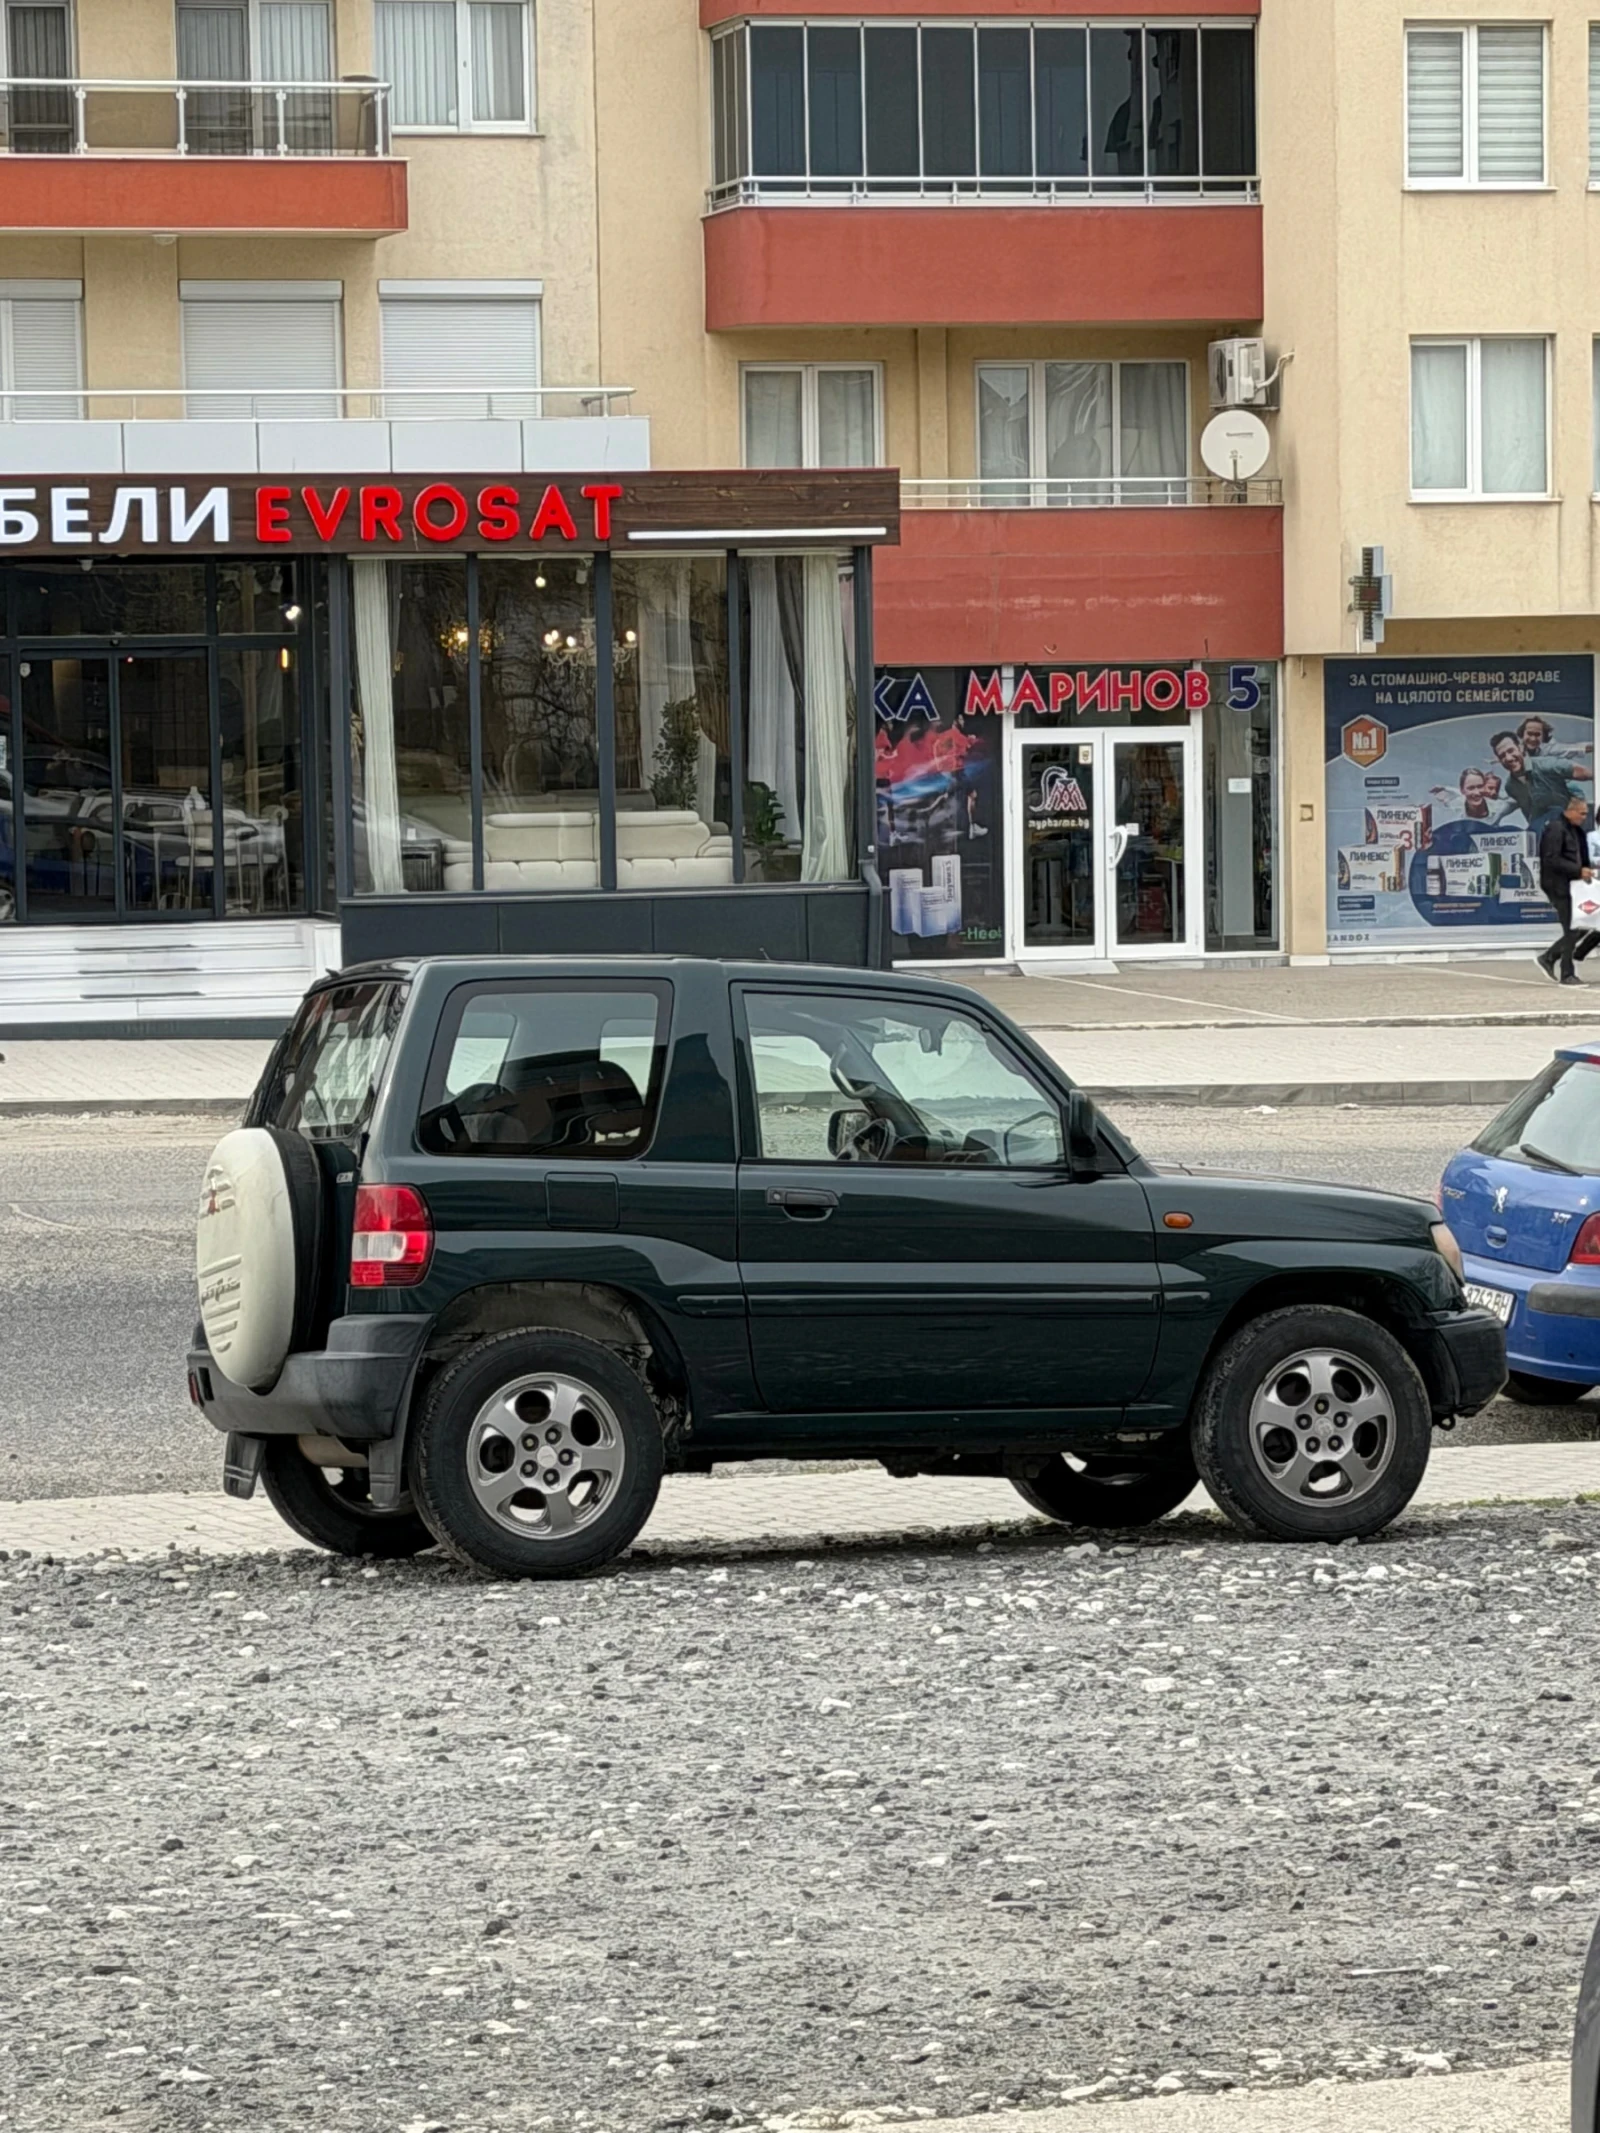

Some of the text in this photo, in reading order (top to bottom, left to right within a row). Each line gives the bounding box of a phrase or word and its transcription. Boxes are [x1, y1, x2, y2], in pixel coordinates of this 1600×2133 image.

[255, 484, 623, 541] EVROSAT
[1349, 670, 1561, 686] ЗА СТОМАШНО-ЧРЕВНО ЗДРАВЕ
[964, 668, 1211, 715] МАРИНОВ
[1225, 665, 1260, 712] 5
[1375, 688, 1535, 706] НА ЦЯЛОТО СЕМЕЙСТВО
[1377, 809, 1418, 821] ЛИНЕКС
[1479, 836, 1518, 847] ЛИНЕКС
[1350, 851, 1391, 862] ЛИНЕКС
[1445, 856, 1484, 868] ЛИНЕКС
